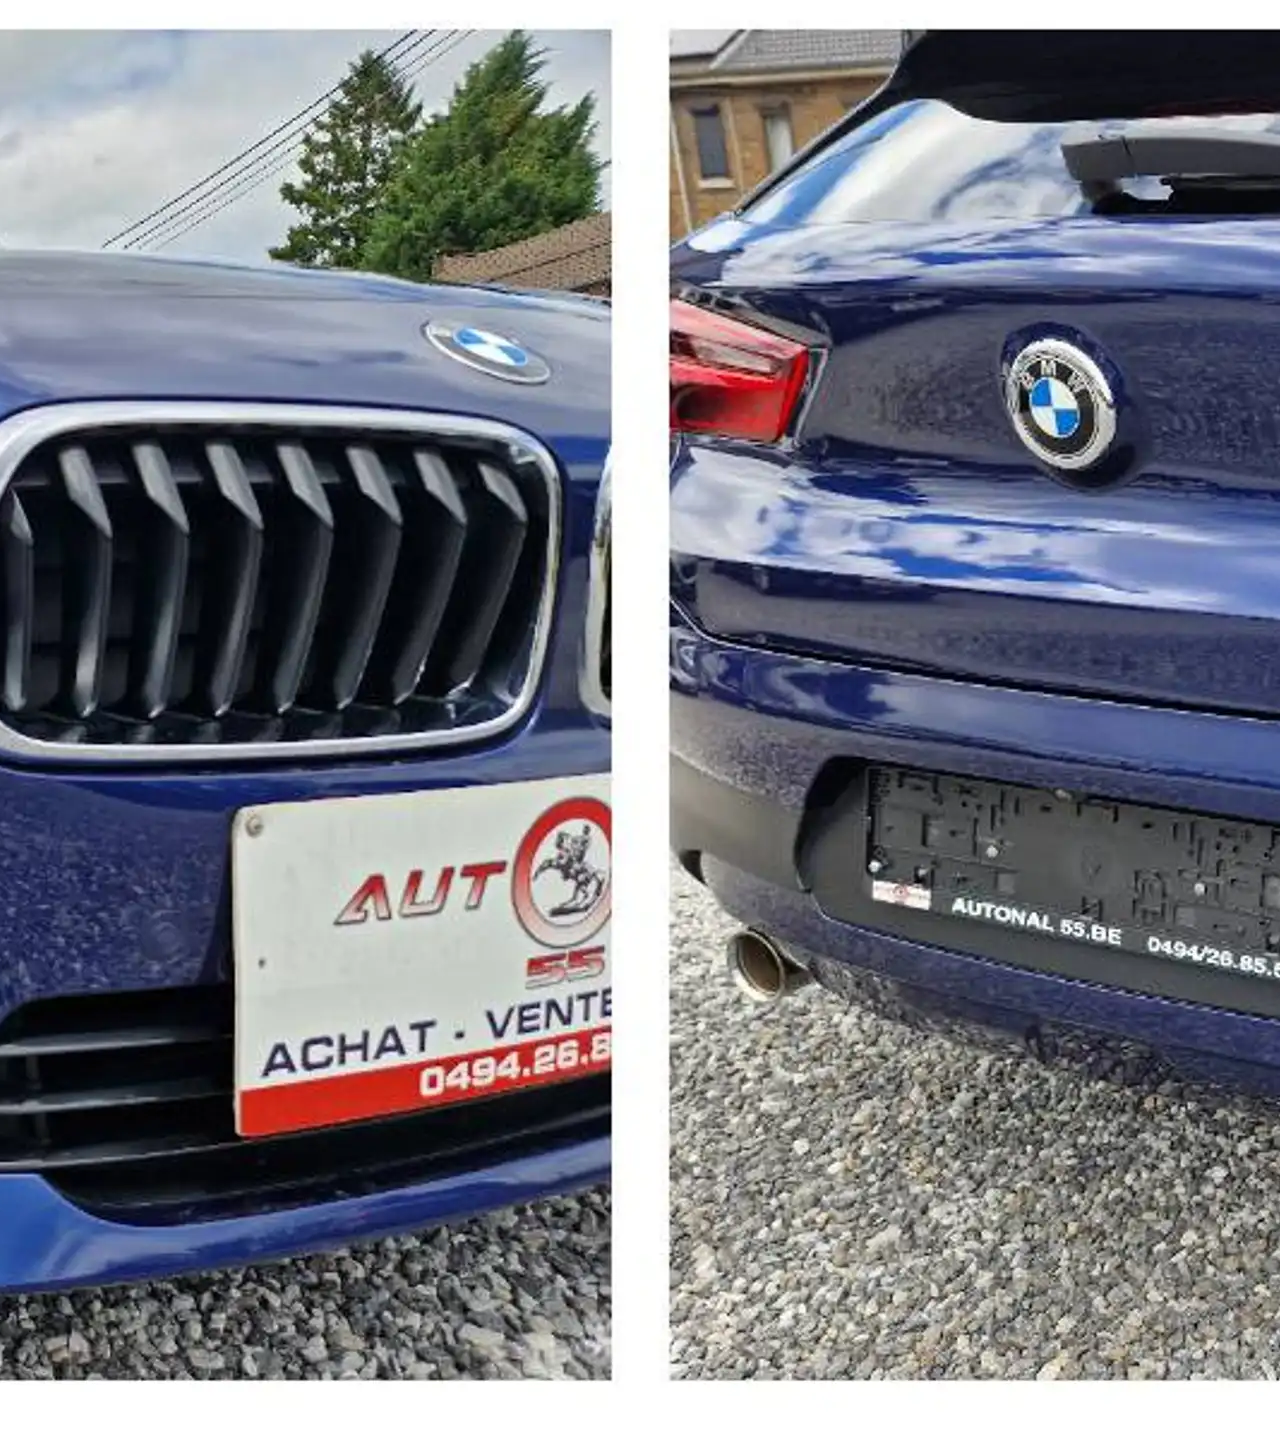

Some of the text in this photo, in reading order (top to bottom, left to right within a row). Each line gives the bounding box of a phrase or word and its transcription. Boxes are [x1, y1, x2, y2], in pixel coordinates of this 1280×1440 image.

[951, 897, 1054, 933] AUTONAL
[1060, 918, 1122, 946] 55.BE
[525, 945, 605, 990] 55
[261, 1020, 437, 1077] ACHAT
